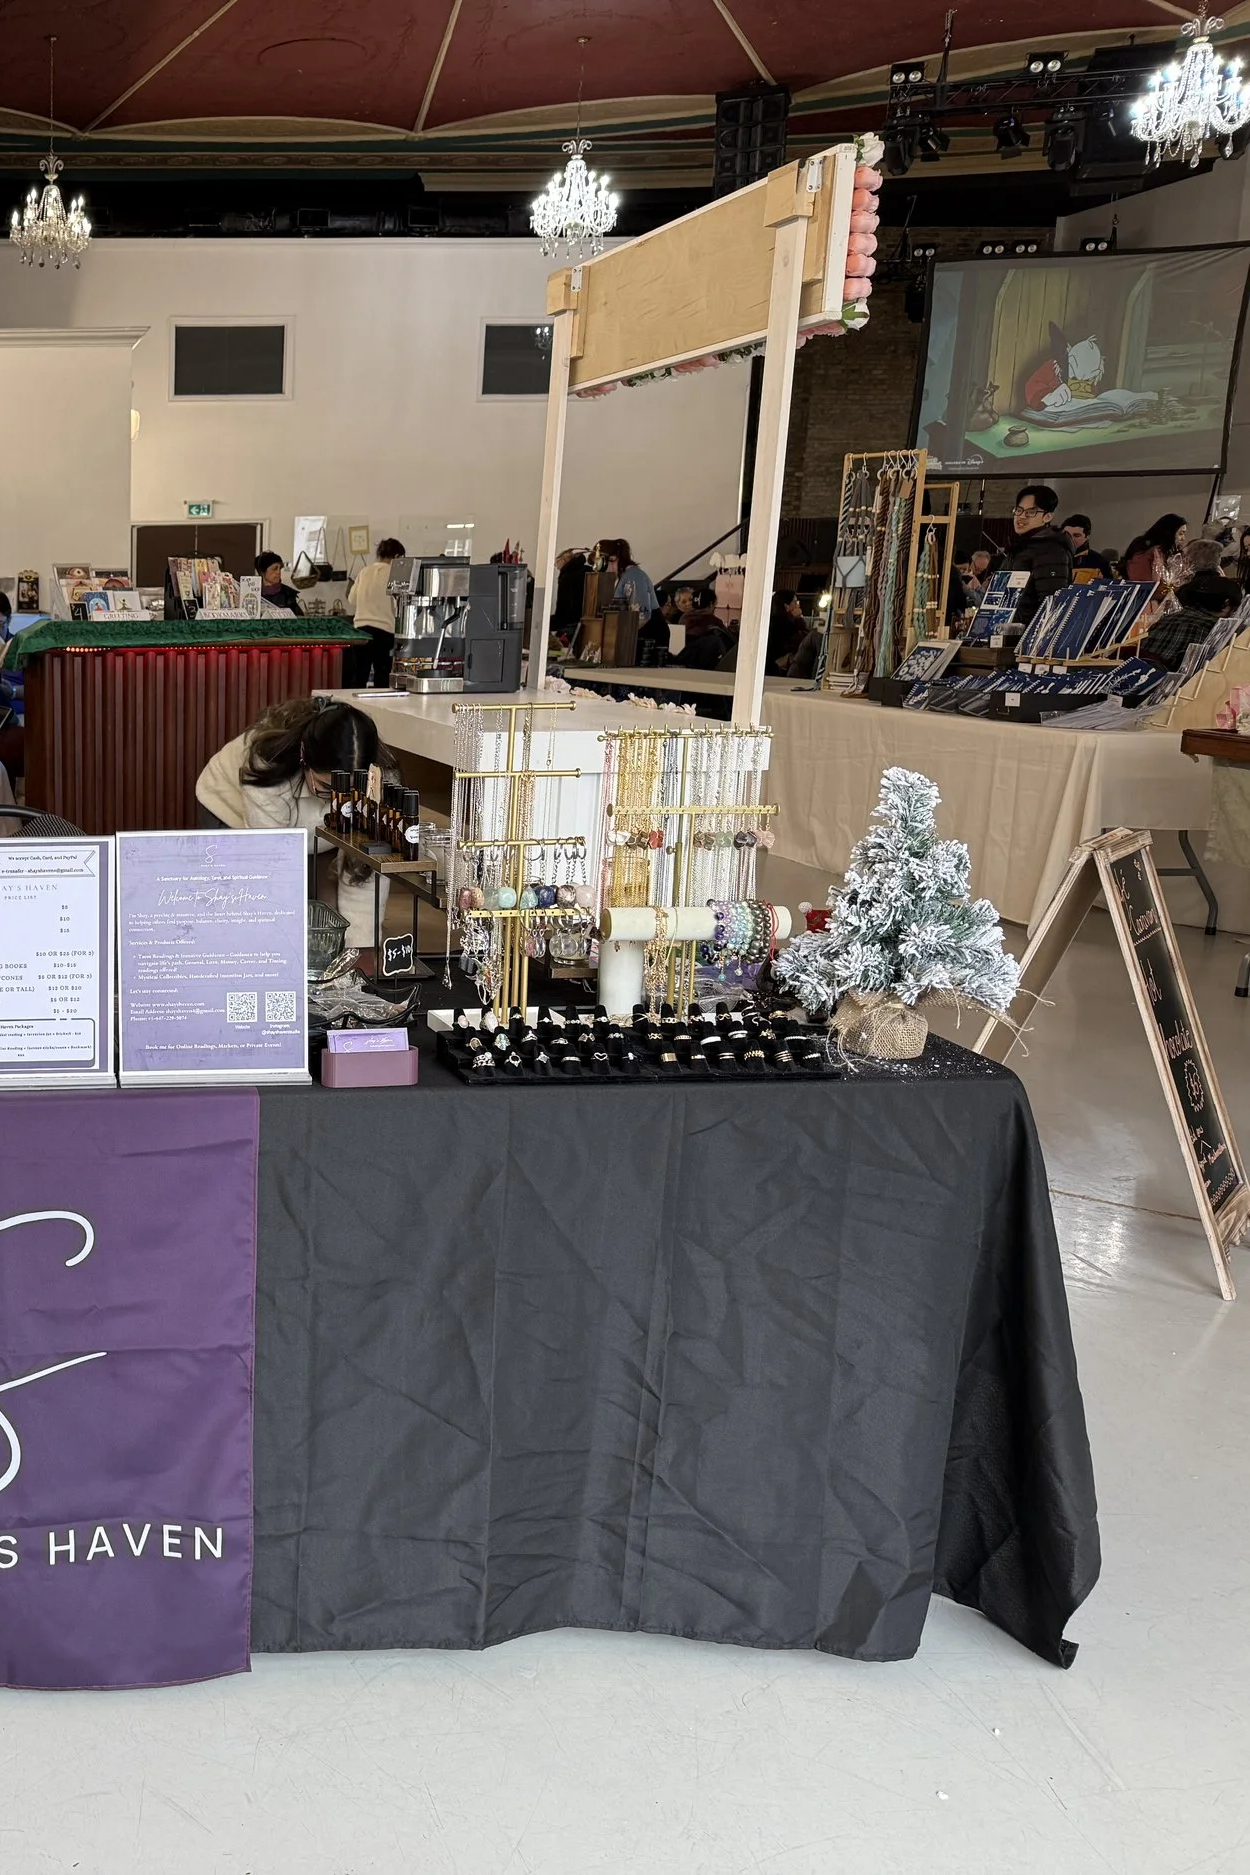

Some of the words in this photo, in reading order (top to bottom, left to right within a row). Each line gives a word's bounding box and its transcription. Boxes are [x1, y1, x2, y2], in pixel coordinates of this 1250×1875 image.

[158, 889, 194, 906] Welcome
[205, 888, 236, 909] Shay's
[234, 888, 268, 903] Haven
[50, 1523, 223, 1565] HAVEN
